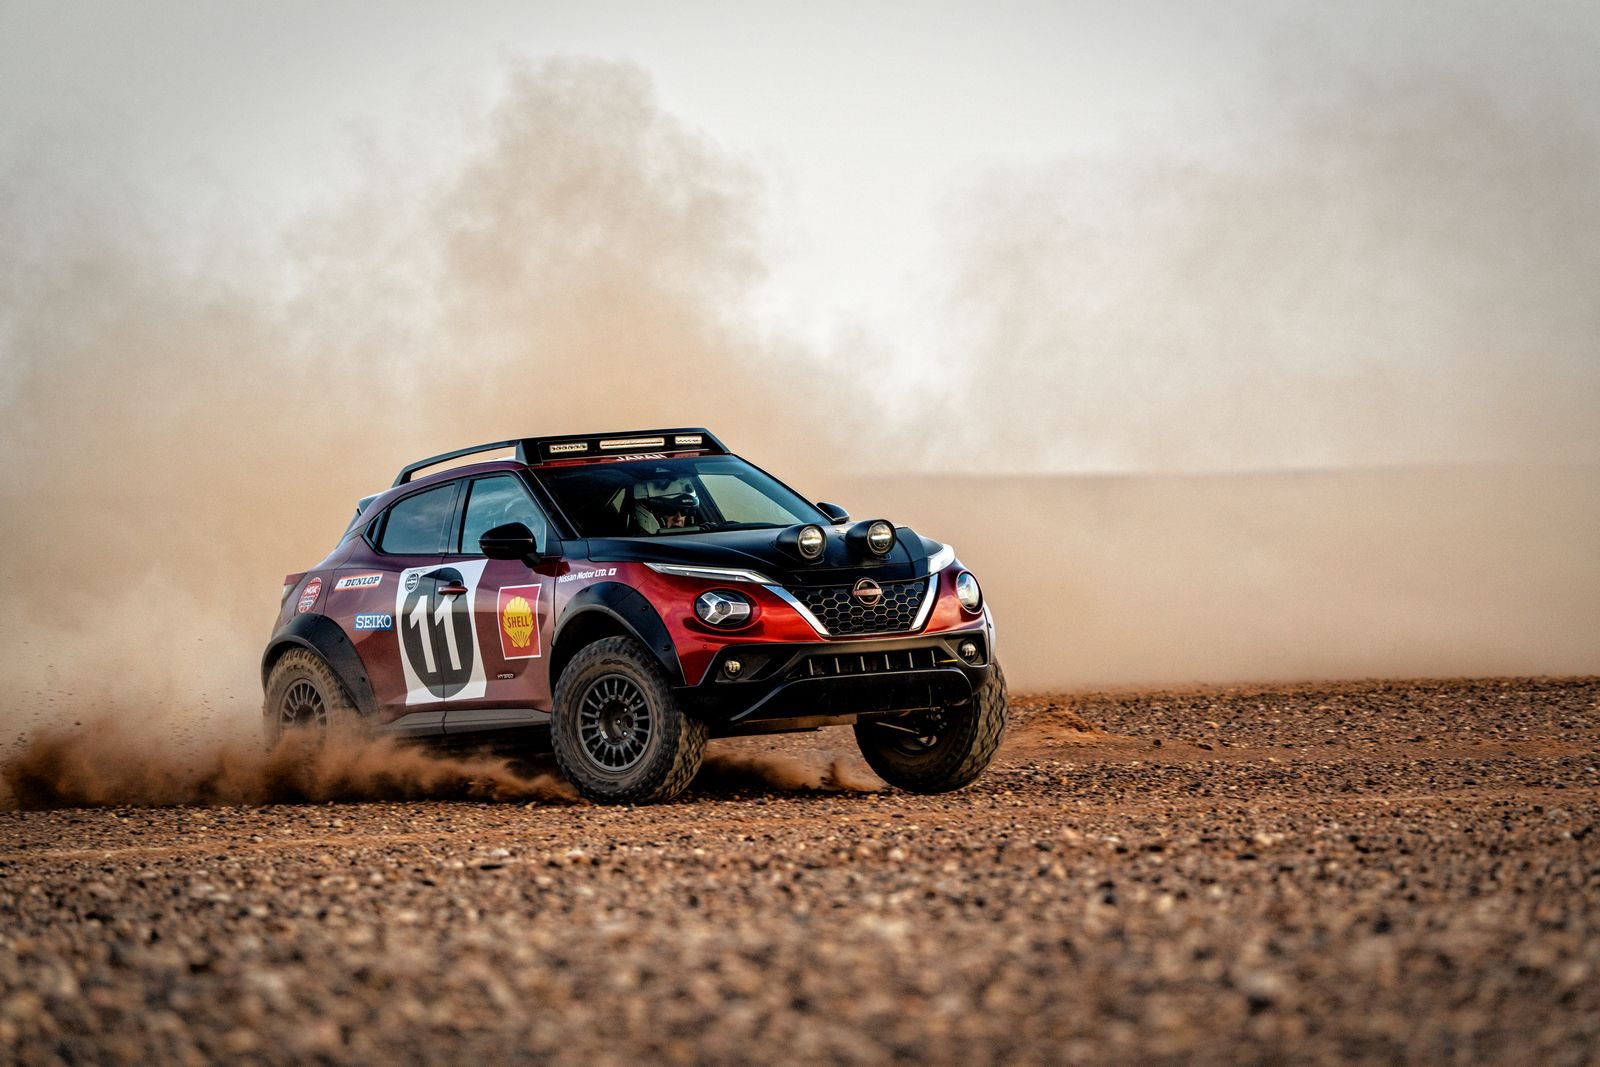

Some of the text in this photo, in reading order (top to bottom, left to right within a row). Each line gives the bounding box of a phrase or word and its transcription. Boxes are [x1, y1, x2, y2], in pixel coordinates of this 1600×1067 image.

[345, 576, 380, 587] DUNLOP
[558, 569, 607, 583] Nissan Motor LTD.
[355, 614, 392, 629] SEIKO
[507, 616, 530, 628] SHELL
[409, 595, 462, 673] 11
